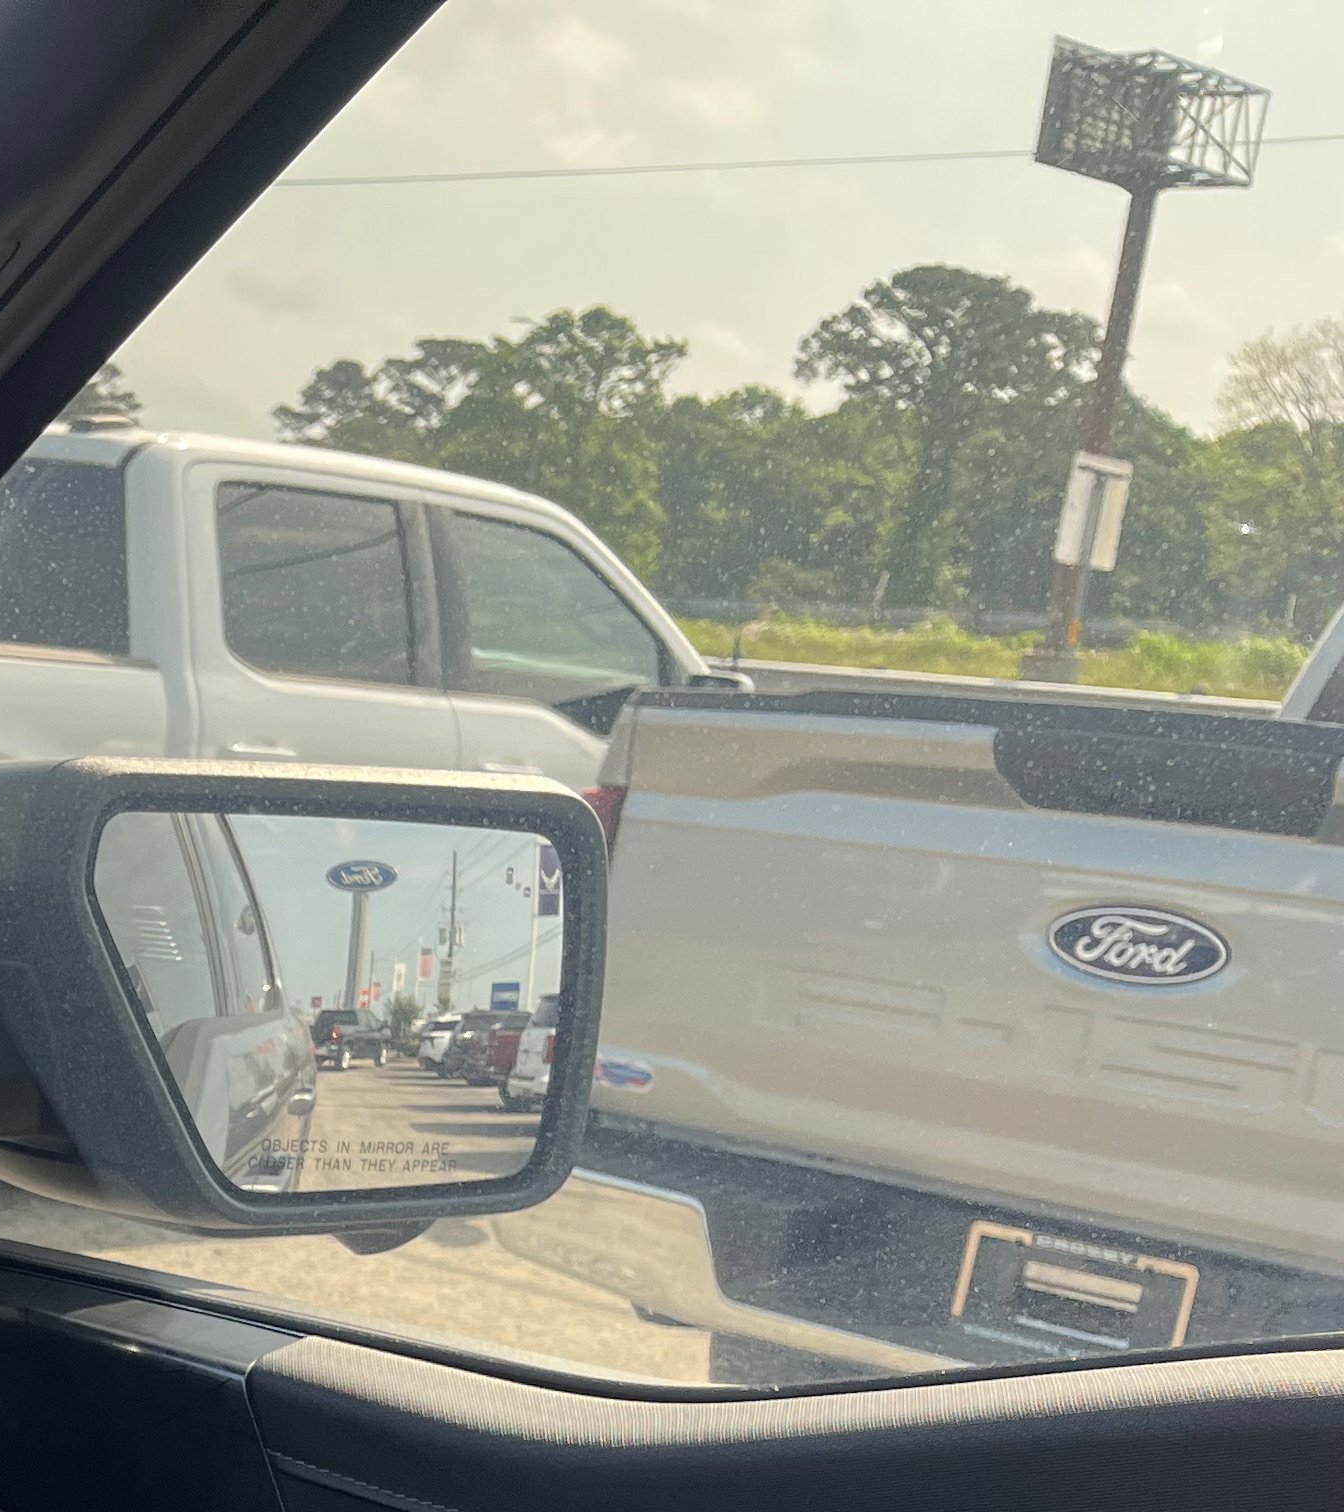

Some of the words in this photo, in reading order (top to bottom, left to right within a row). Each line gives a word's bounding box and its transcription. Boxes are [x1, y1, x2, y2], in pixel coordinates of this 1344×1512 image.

[1076, 915, 1188, 977] Ford
[261, 1138, 328, 1153] OBJECTS
[336, 1141, 351, 1153] IN
[359, 1141, 414, 1155] MIRROR
[422, 1142, 450, 1155] ARE
[247, 1155, 305, 1170] CLOSER
[314, 1157, 352, 1171] THAN
[361, 1158, 397, 1172] THEY
[402, 1159, 458, 1173] APPEAR
